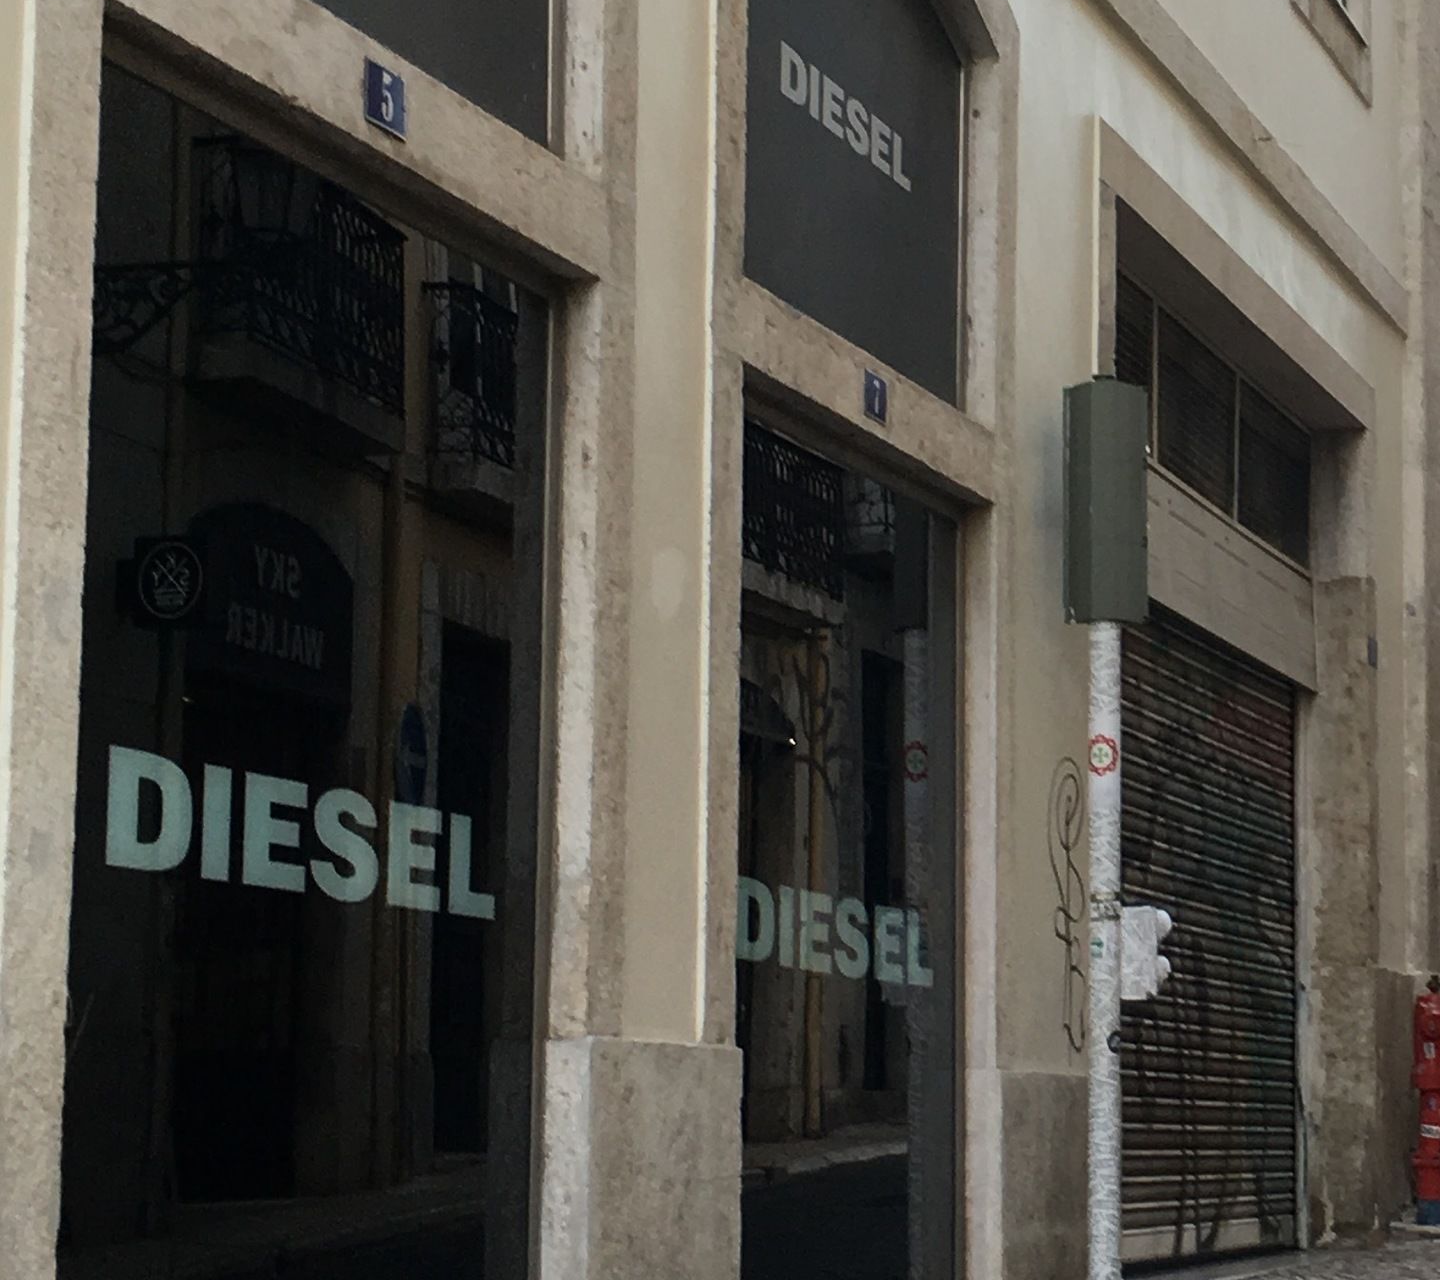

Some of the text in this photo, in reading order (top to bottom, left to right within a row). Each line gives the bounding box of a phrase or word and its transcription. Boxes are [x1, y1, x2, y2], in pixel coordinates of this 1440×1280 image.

[381, 70, 394, 122] 5
[780, 39, 911, 192] DIESEL
[105, 744, 496, 920] DIESEL
[736, 875, 934, 987] DIESEL
